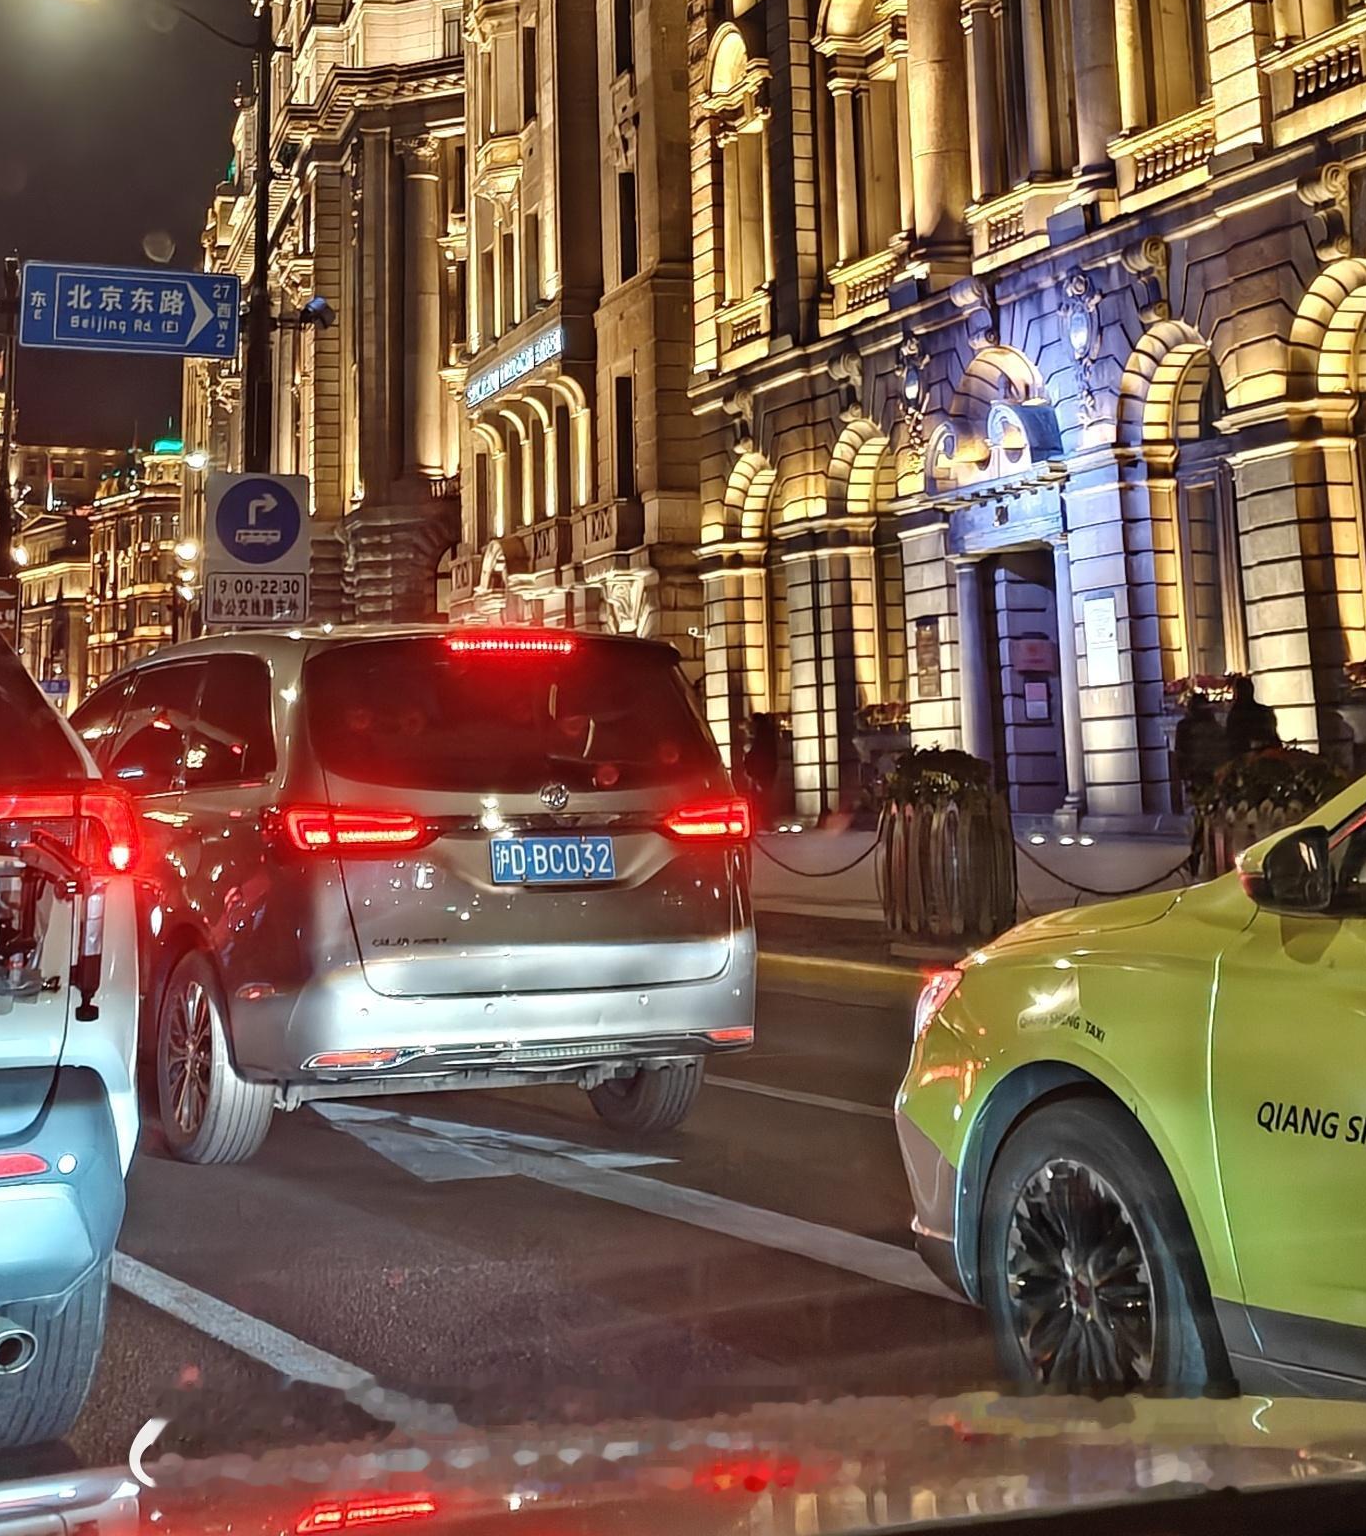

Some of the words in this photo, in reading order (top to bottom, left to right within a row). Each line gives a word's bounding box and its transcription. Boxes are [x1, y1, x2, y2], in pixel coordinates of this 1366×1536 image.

[30, 291, 47, 308] 东
[67, 284, 185, 316] 北京东路
[212, 283, 231, 299] 27
[216, 302, 232, 319] 西
[70, 315, 126, 335] Beijing
[216, 334, 226, 348] 2
[1085, 1020, 1106, 1044] TAXI
[1257, 1101, 1340, 1140] QIANG
